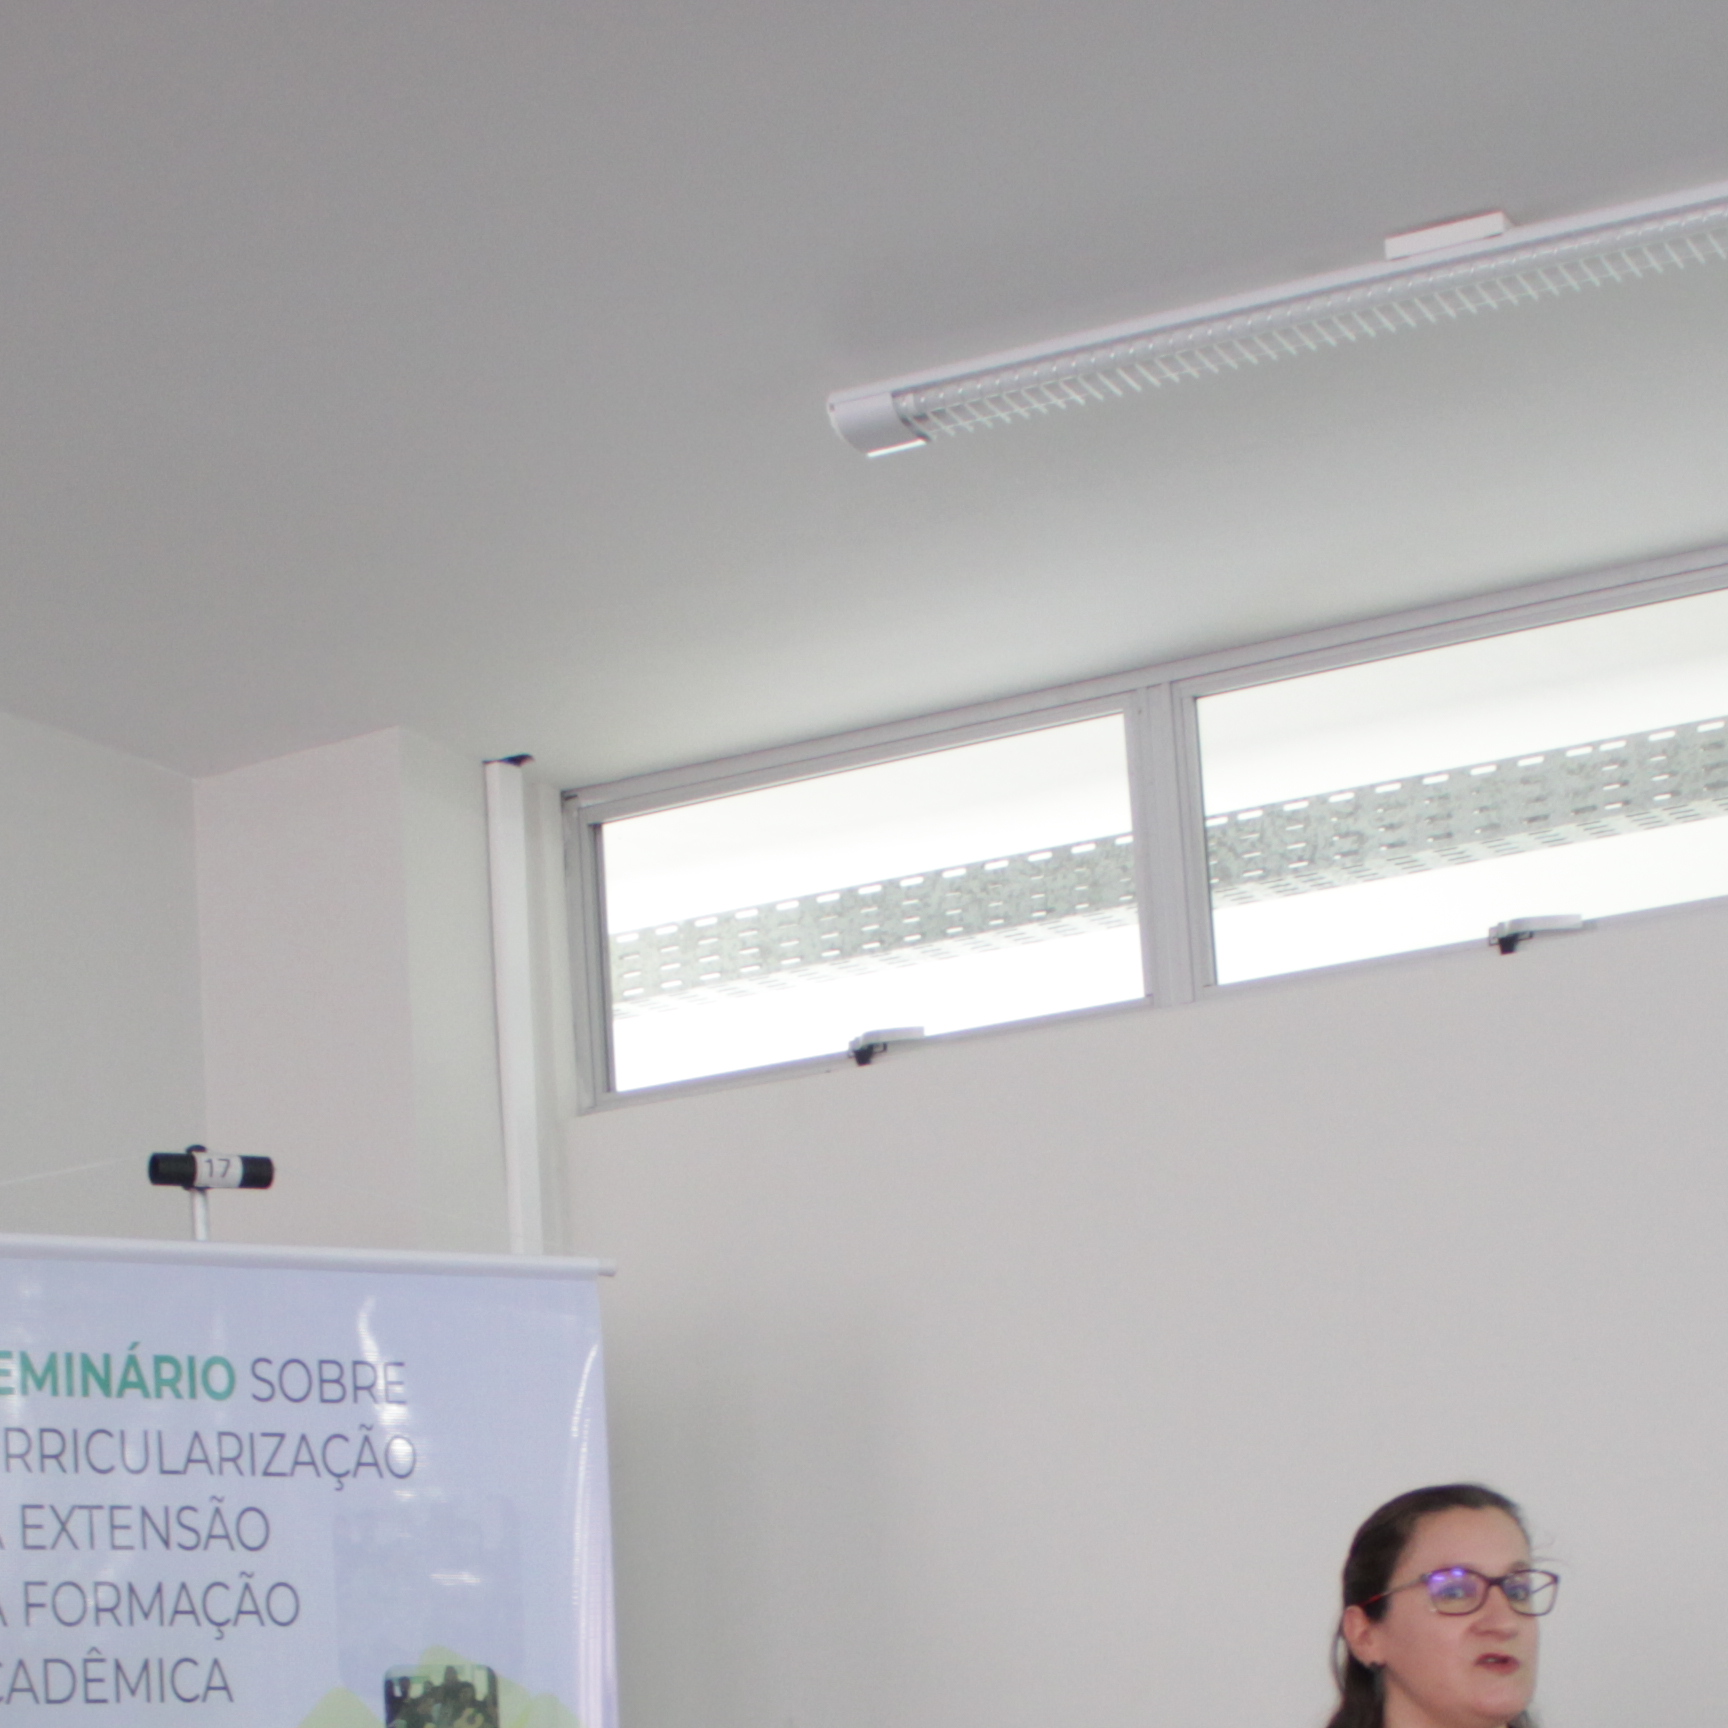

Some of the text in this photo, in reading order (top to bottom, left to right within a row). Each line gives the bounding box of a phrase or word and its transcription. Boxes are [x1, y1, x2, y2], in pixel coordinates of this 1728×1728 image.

[204, 1158, 231, 1179] 17
[250, 1357, 408, 1406] SOBRE
[21, 1495, 271, 1552] EXTENSÃO
[23, 1570, 301, 1641] FORMAÇÃO
